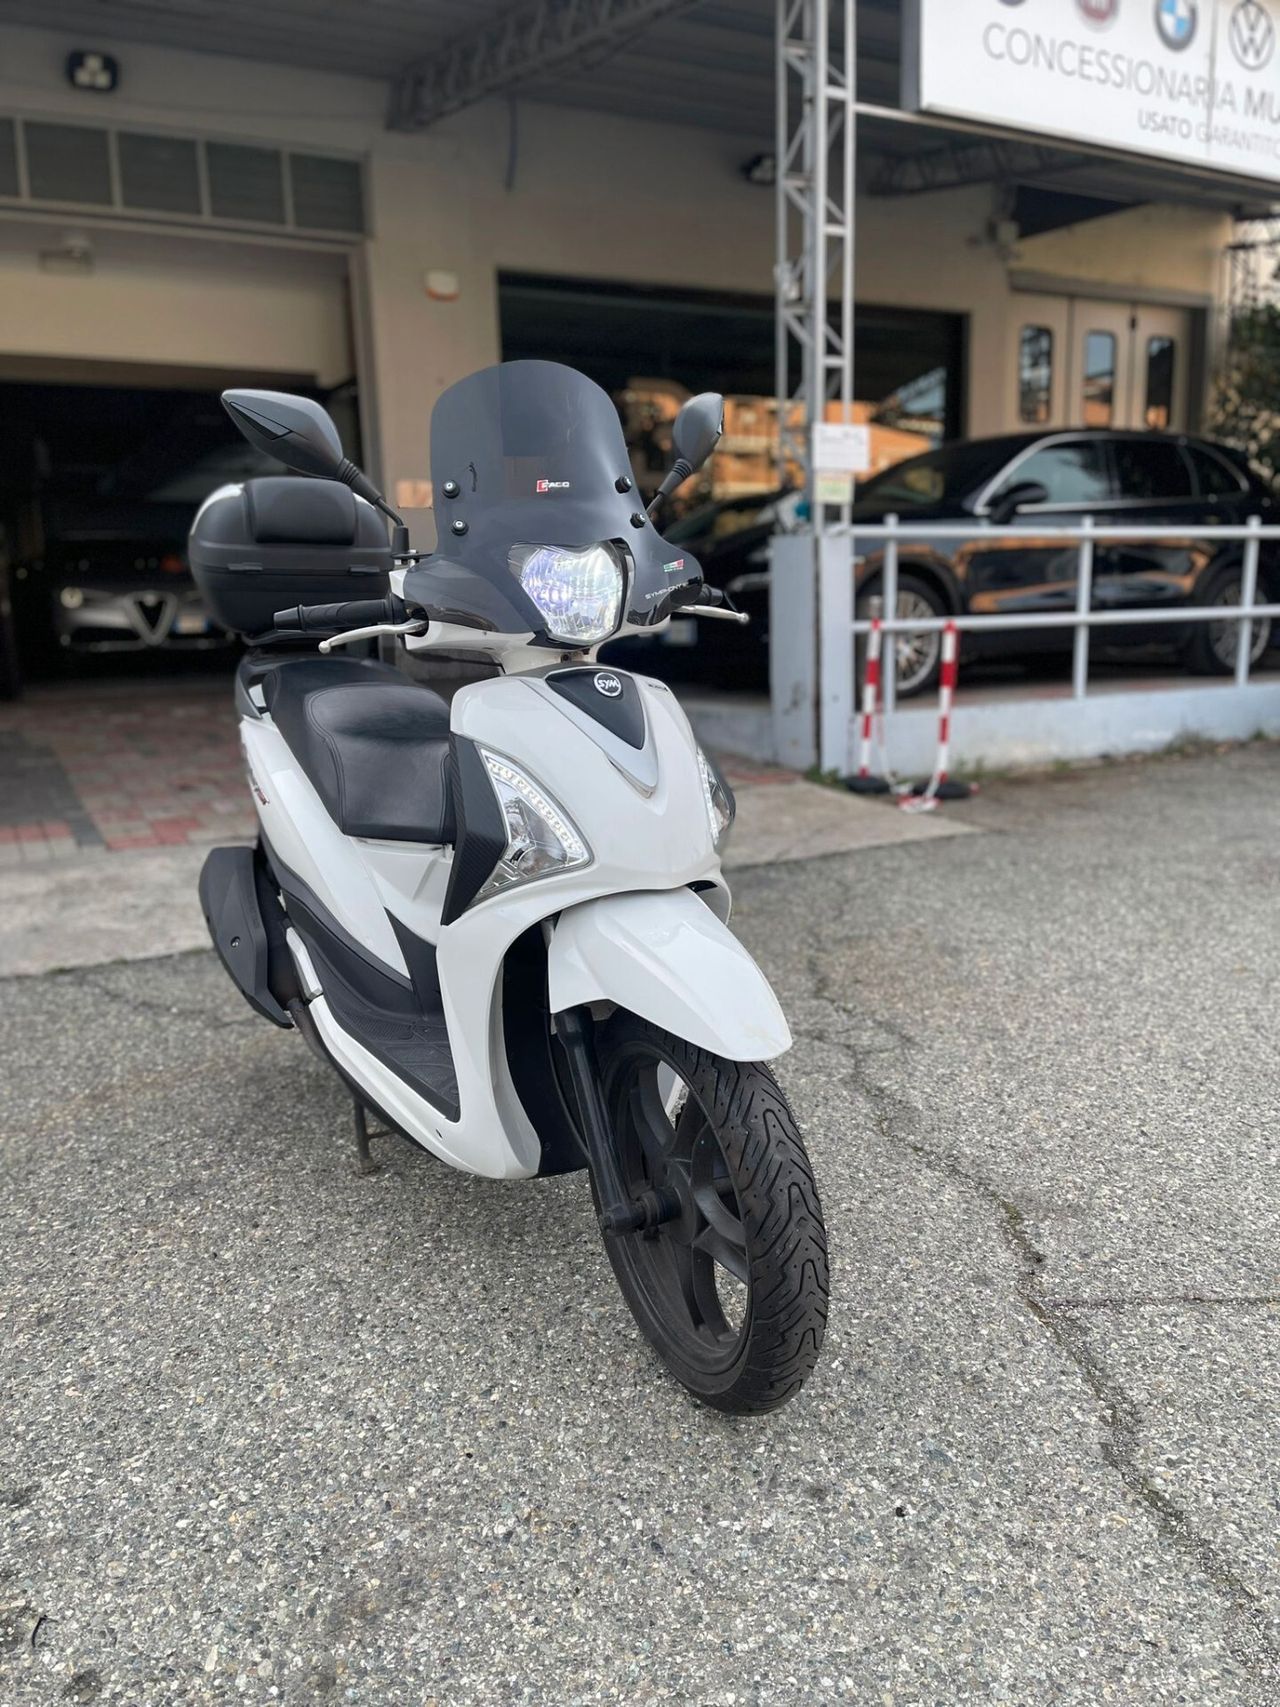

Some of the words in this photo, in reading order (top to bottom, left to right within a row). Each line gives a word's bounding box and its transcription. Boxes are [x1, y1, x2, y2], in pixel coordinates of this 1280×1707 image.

[982, 21, 1237, 114] CONCESSIONARIA
[1137, 108, 1193, 139] USATO
[598, 679, 619, 690] SYM
